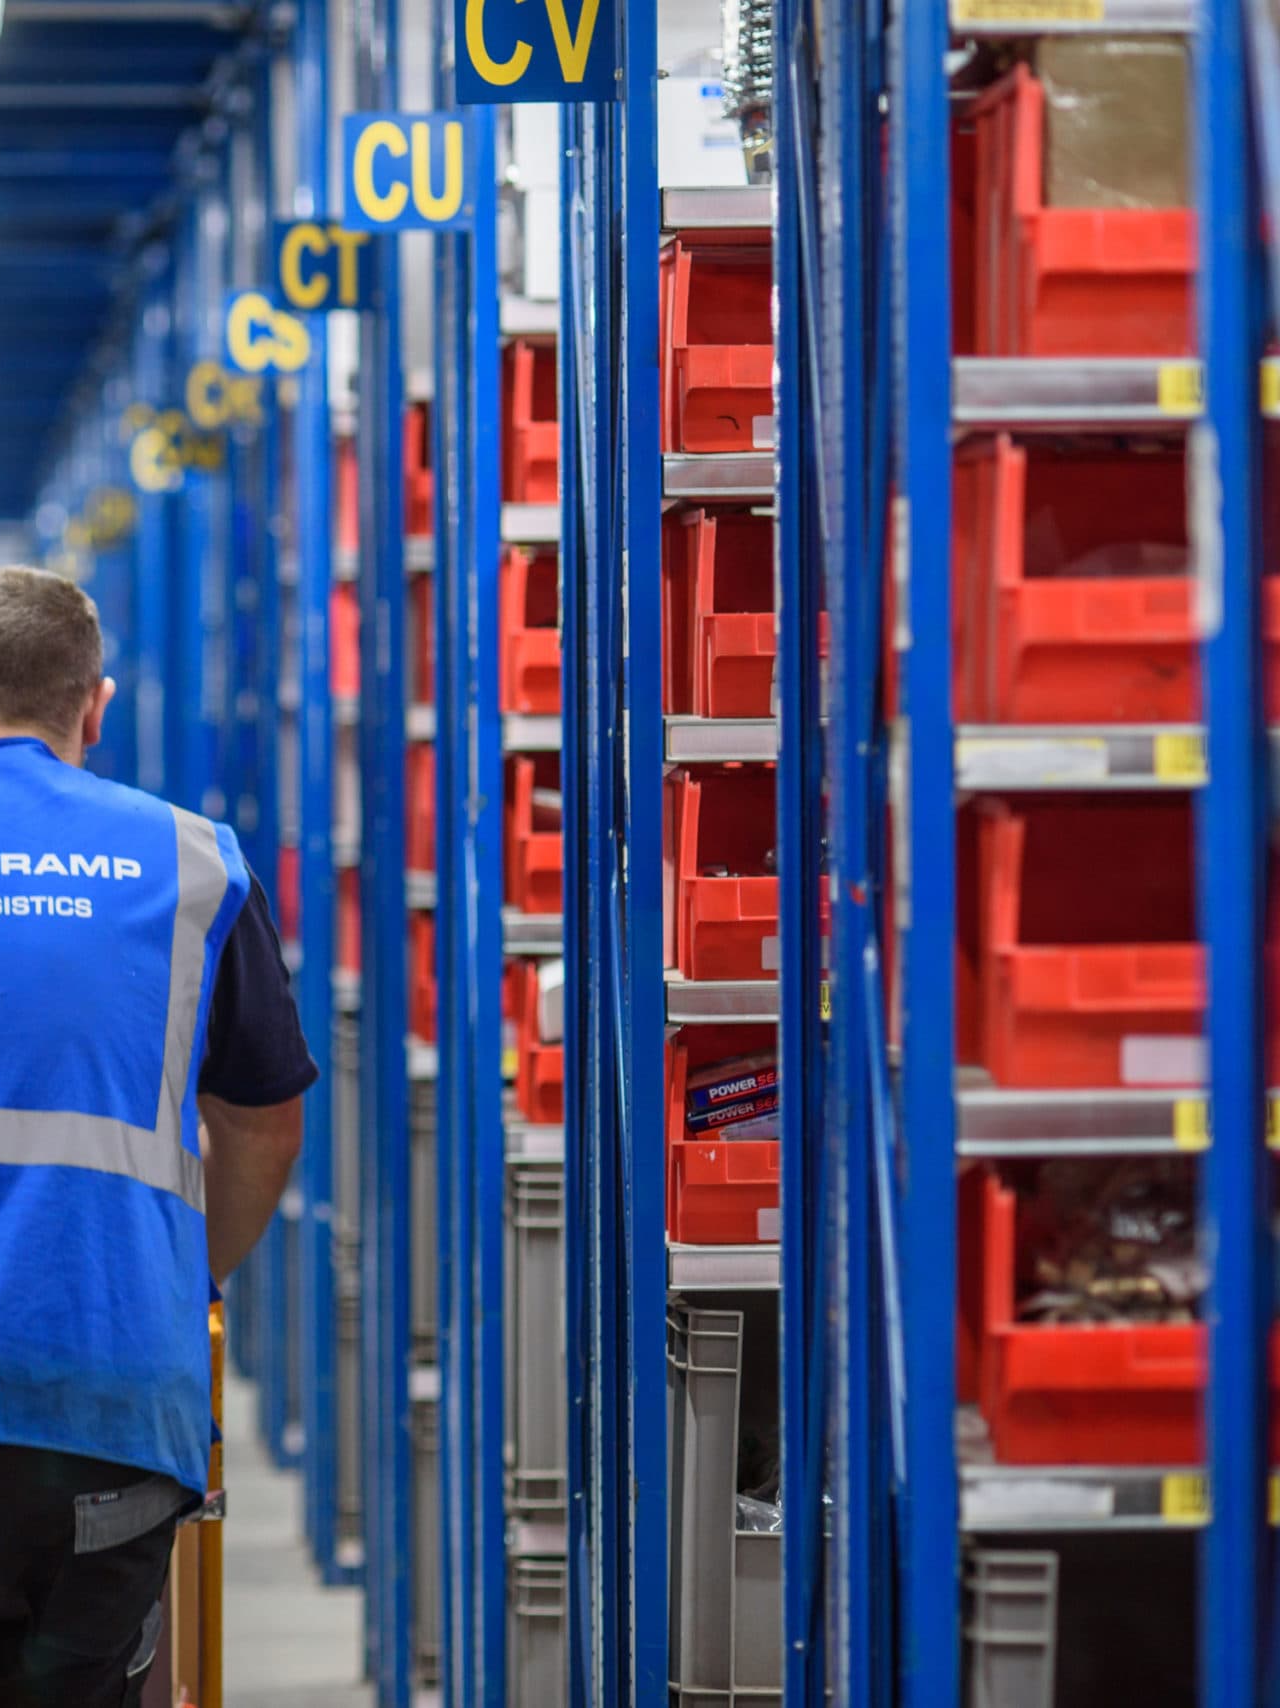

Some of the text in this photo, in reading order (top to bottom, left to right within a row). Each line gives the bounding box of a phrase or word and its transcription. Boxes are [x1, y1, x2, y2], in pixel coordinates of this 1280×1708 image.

[465, 0, 599, 86] CV
[353, 120, 464, 223] CU
[279, 223, 370, 309] CT
[227, 292, 311, 372] CS
[707, 1103, 754, 1122] POWER
[708, 1078, 756, 1099] POWER
